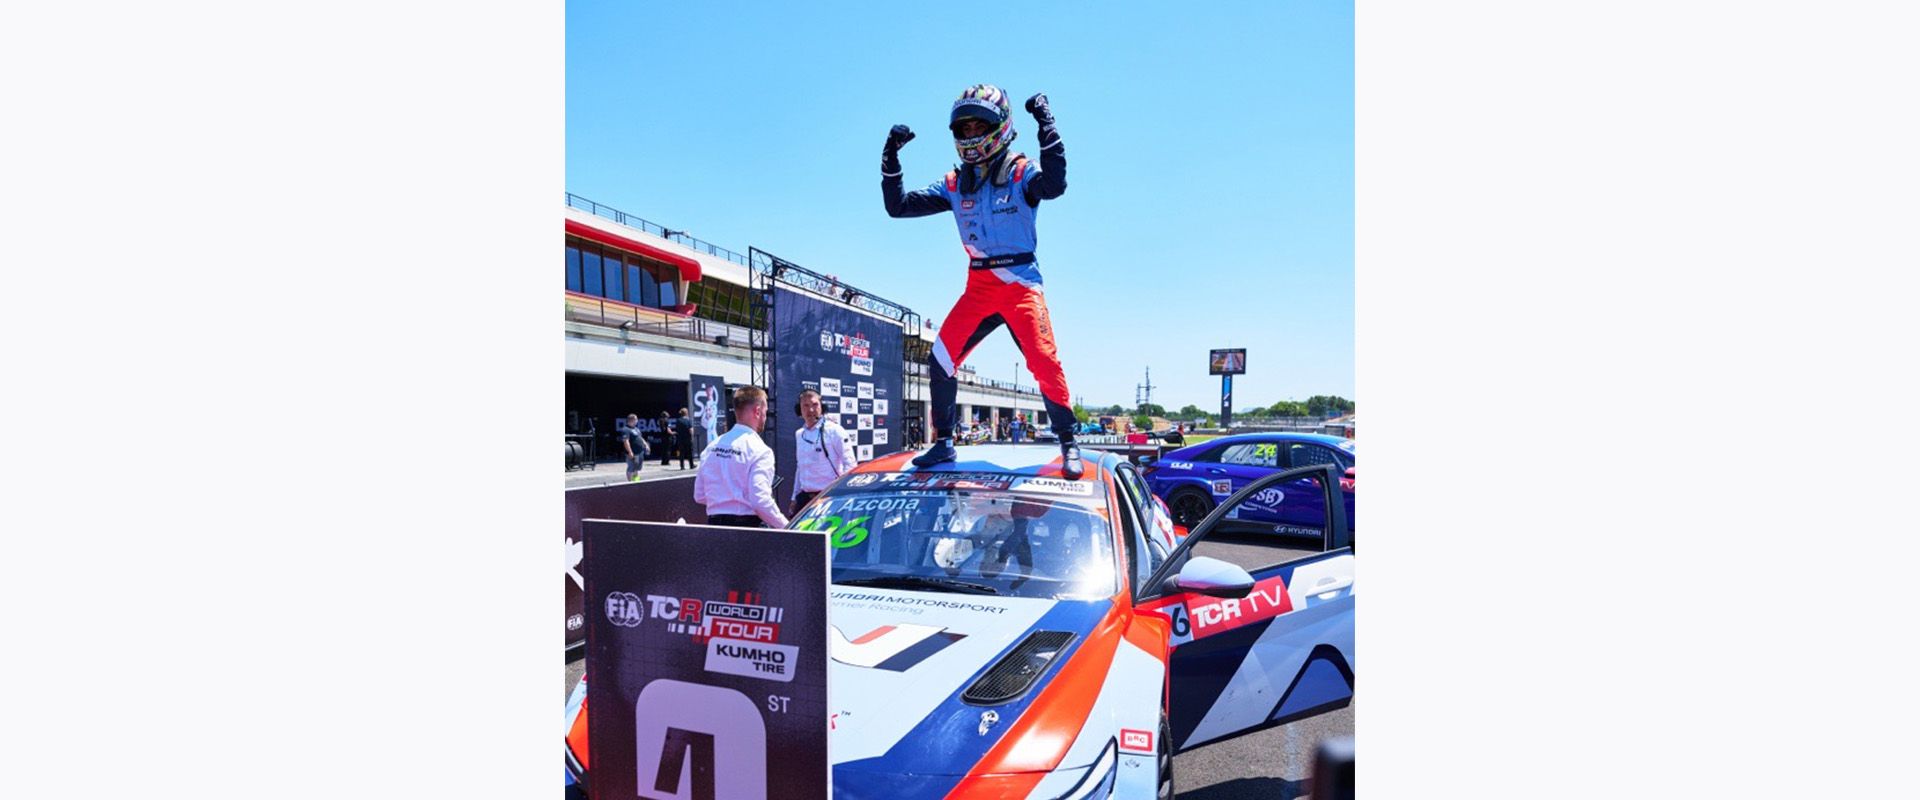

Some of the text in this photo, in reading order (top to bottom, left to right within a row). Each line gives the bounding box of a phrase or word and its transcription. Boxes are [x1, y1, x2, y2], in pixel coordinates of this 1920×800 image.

[1255, 444, 1277, 456] 24
[881, 472, 936, 484] TCR
[1023, 479, 1085, 489] KUMHO
[811, 498, 920, 516] M. Azcona
[1288, 527, 1321, 536] HYUNDAI
[647, 594, 703, 622] TCR
[709, 604, 760, 618] WORLD
[831, 591, 1008, 615] UNDAI MOTORSPORT
[1192, 599, 1241, 629] TCR
[1243, 585, 1280, 612] TV
[716, 621, 773, 640] TOUR
[716, 644, 785, 664] KUMHO
[752, 661, 785, 675] TIRE
[767, 695, 790, 713] ST
